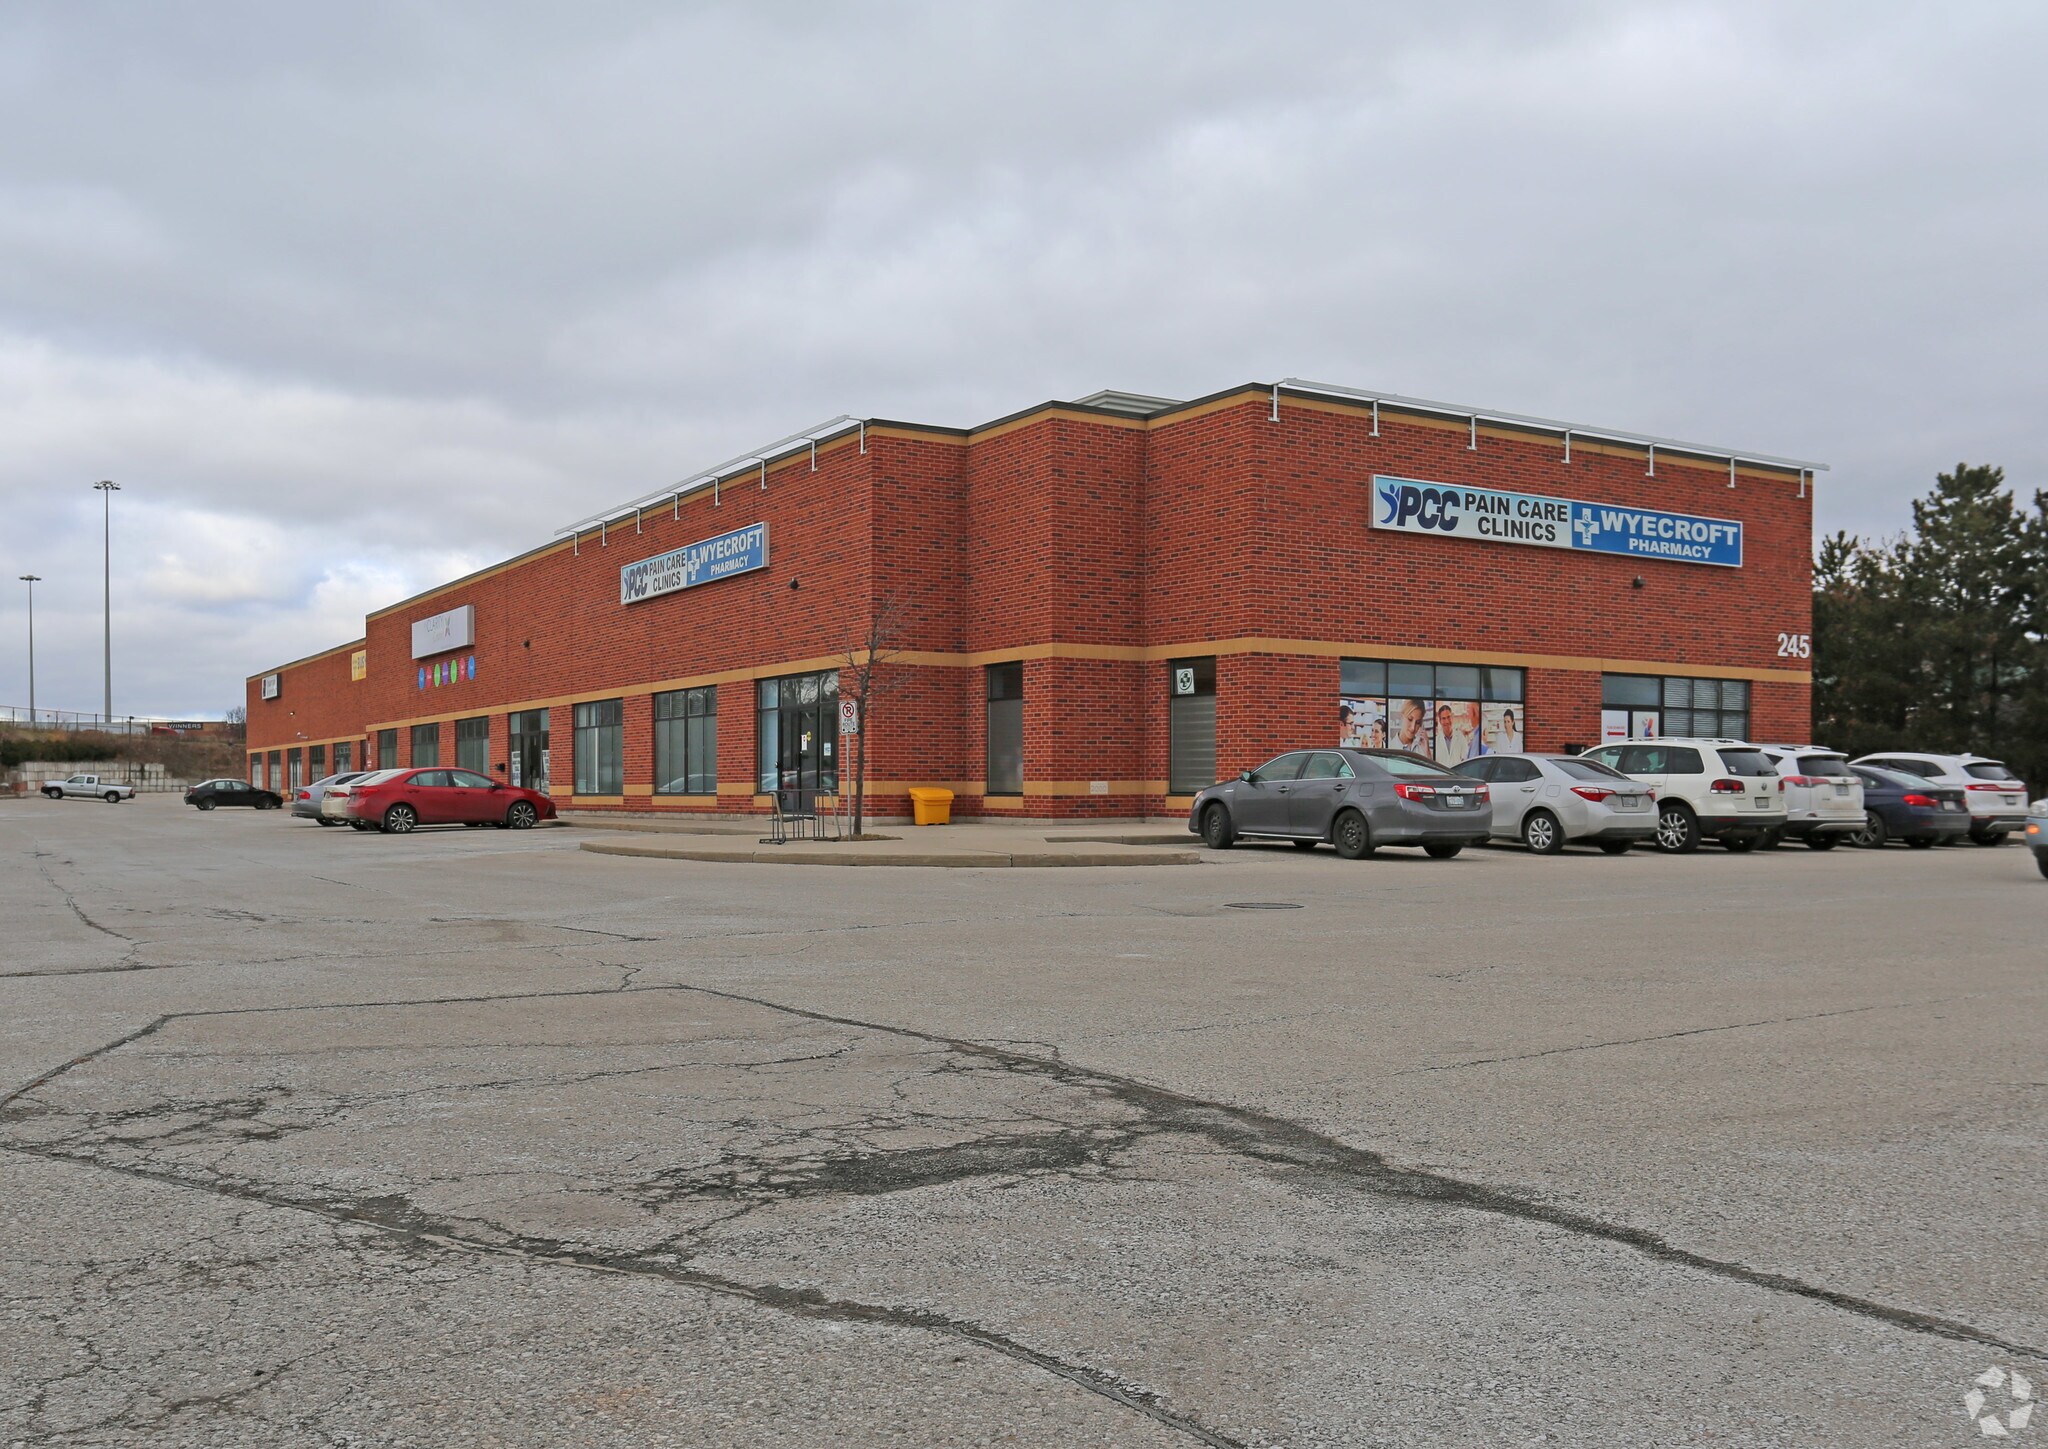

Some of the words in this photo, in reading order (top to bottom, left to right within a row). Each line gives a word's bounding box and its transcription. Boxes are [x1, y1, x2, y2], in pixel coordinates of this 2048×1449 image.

[1397, 485, 1460, 531] PCC
[1464, 493, 1510, 516] PAIN
[1517, 499, 1568, 523] CARE
[1477, 516, 1556, 542] CLINICS
[1600, 510, 1738, 546] WYECROFT
[699, 528, 762, 564] WYECROFT
[1629, 538, 1712, 559] PHARMACY
[628, 564, 649, 599] PCC
[649, 558, 665, 577] PAIN
[666, 552, 686, 571] CARE
[710, 555, 749, 576] PHARMACY
[652, 571, 681, 592] CLINICS
[1777, 633, 1810, 659] 245
